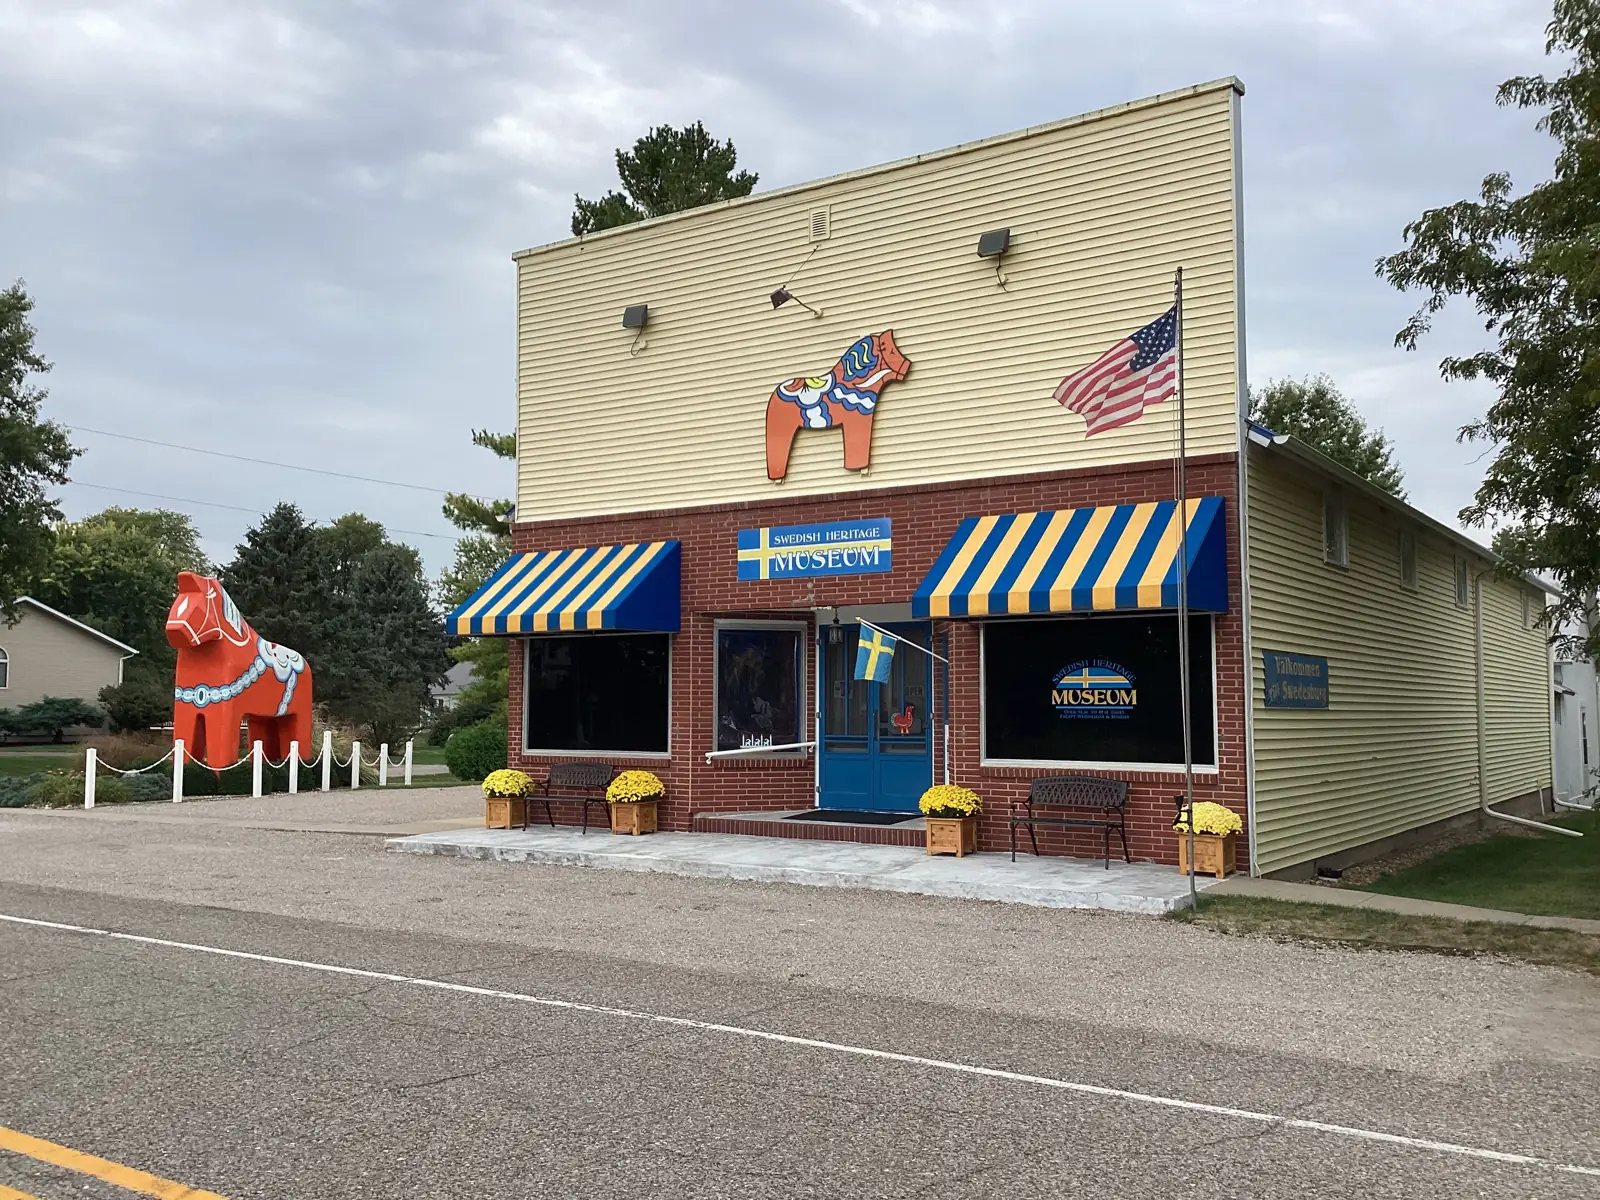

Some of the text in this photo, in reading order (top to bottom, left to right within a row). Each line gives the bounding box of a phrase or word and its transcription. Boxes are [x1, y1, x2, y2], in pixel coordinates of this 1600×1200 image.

[774, 527, 880, 545] SWEDISH HERITAGE
[774, 544, 880, 572] MUSEUM
[1052, 659, 1137, 685] SWEDISH HERITAGE
[1051, 689, 1138, 705] MUSEUM
